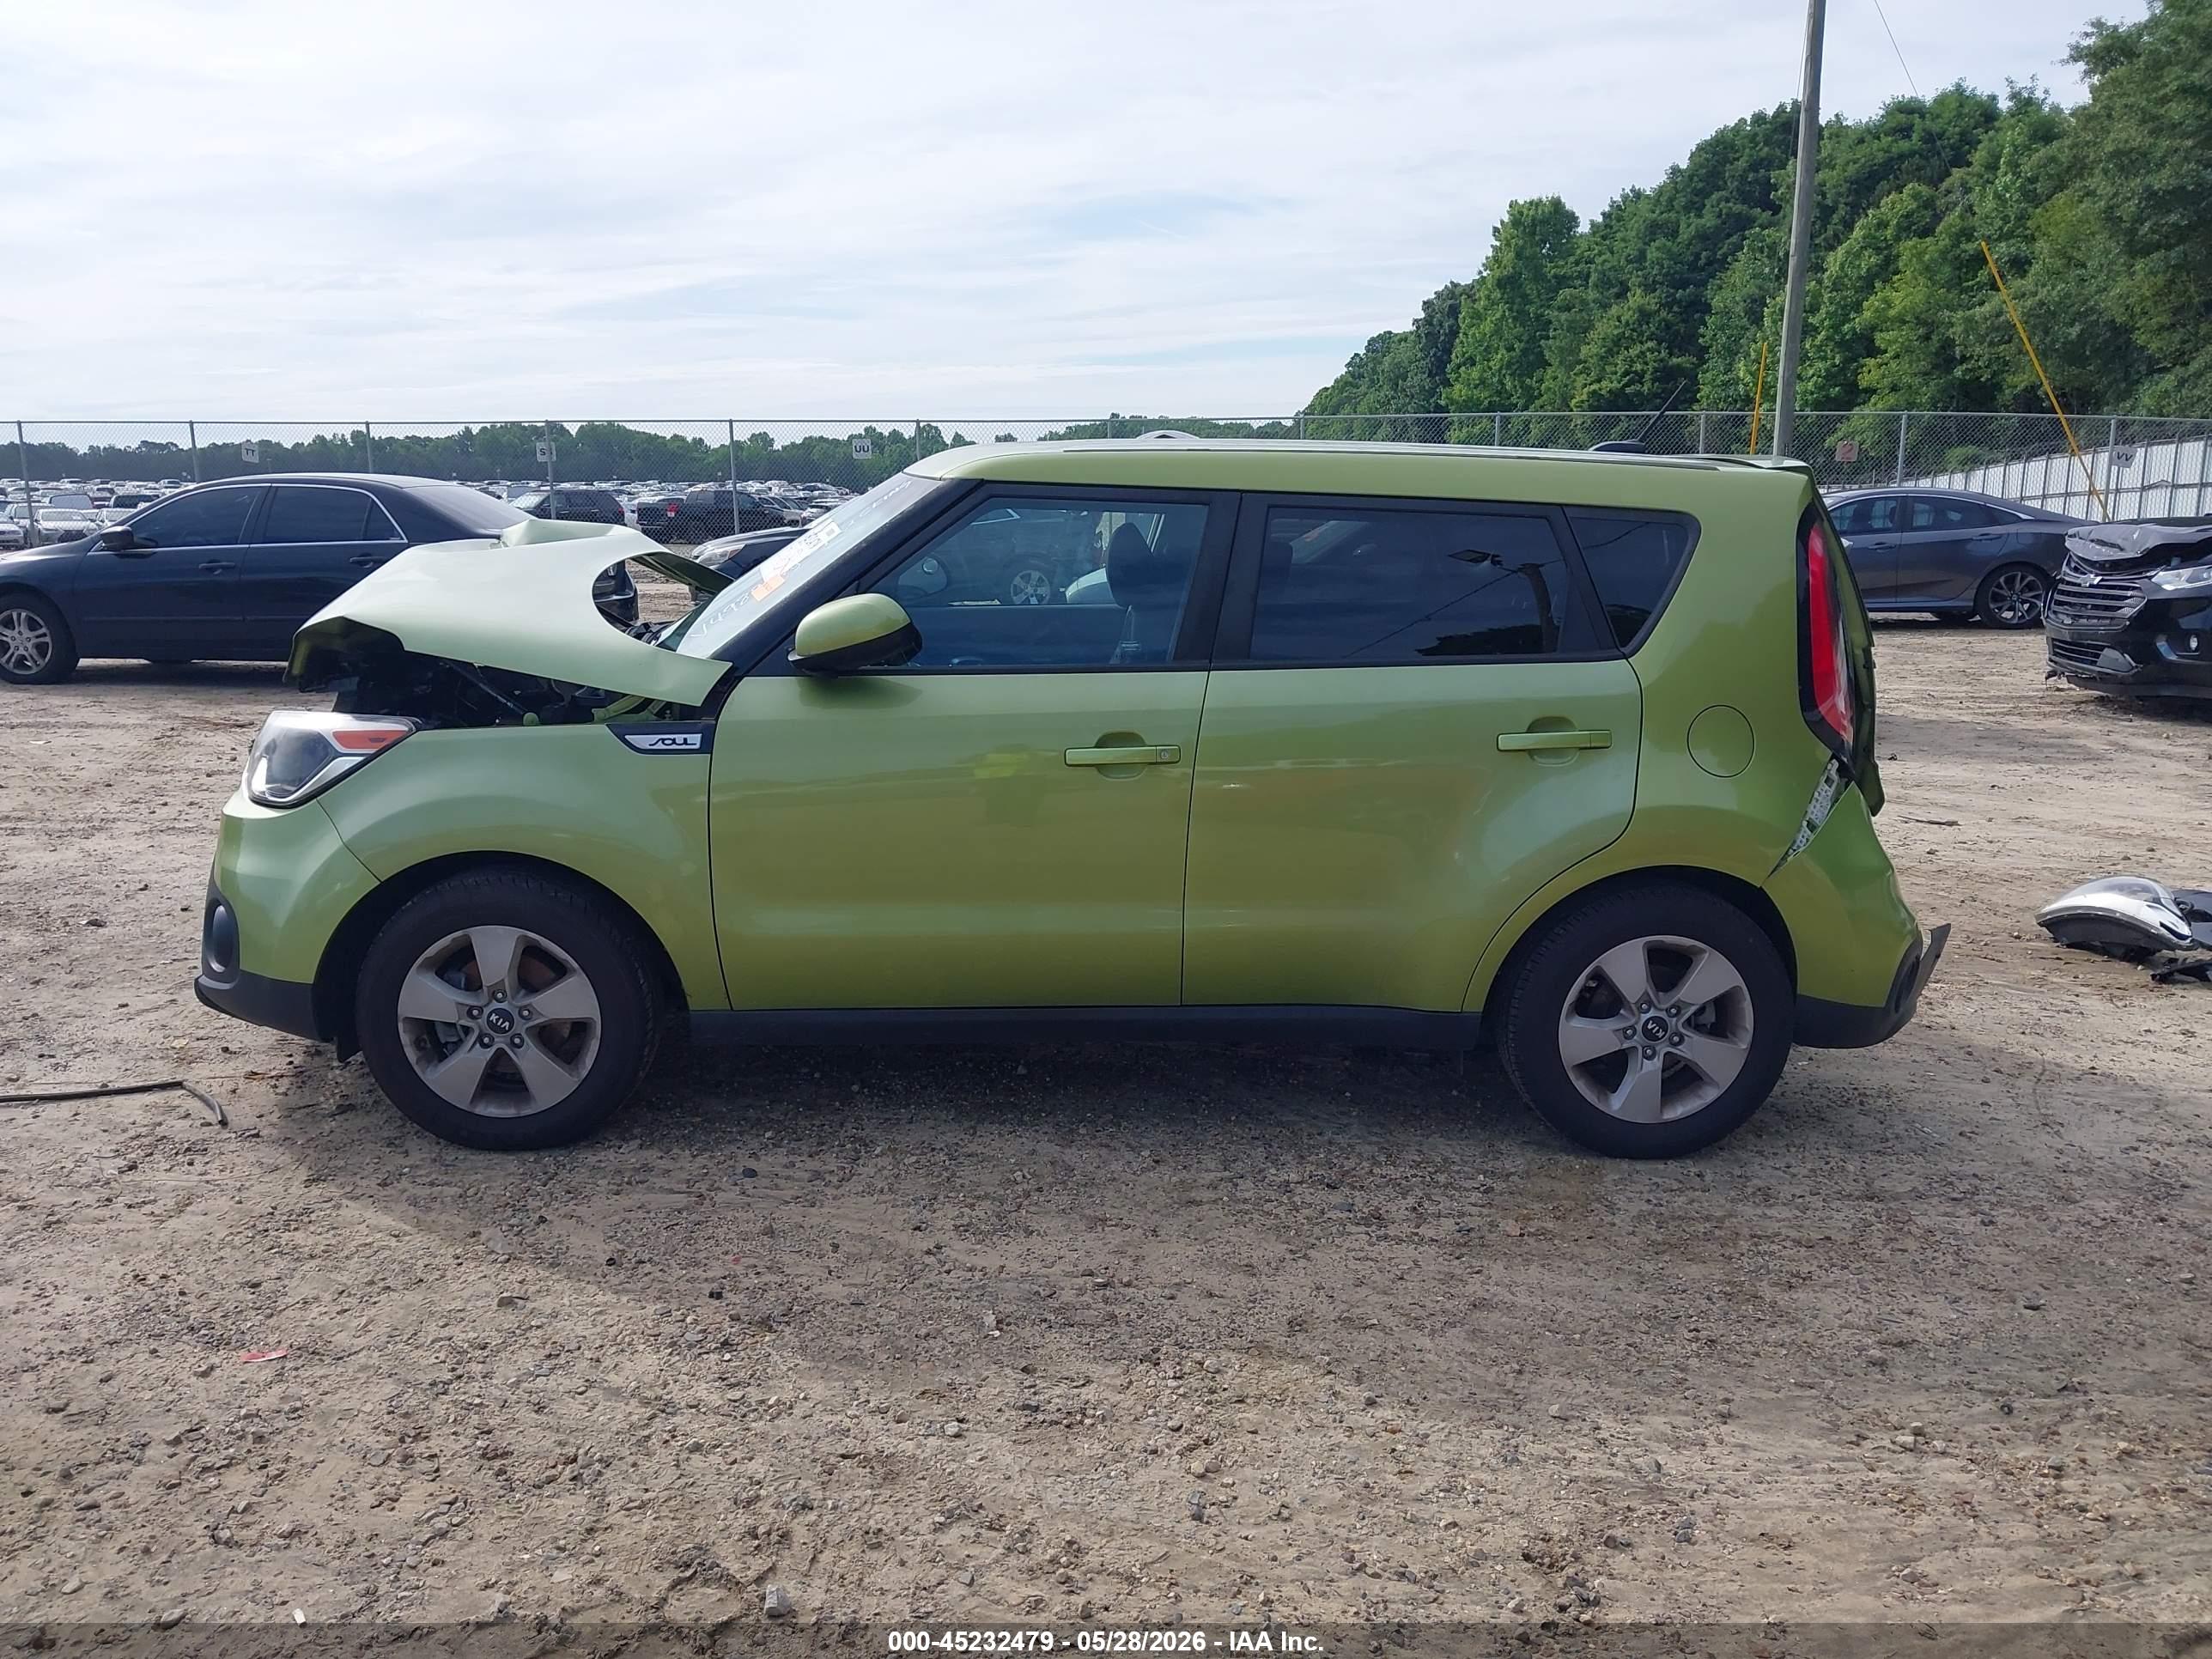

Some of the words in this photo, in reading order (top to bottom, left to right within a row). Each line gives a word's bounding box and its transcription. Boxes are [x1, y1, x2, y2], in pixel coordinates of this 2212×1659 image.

[244, 447, 256, 457] TT
[539, 447, 554, 456] S
[854, 445, 870, 453] UU
[2117, 452, 2133, 461] VV
[648, 738, 697, 746] SOUL
[489, 1012, 510, 1030] KIA
[1647, 1020, 1666, 1038] KIA
